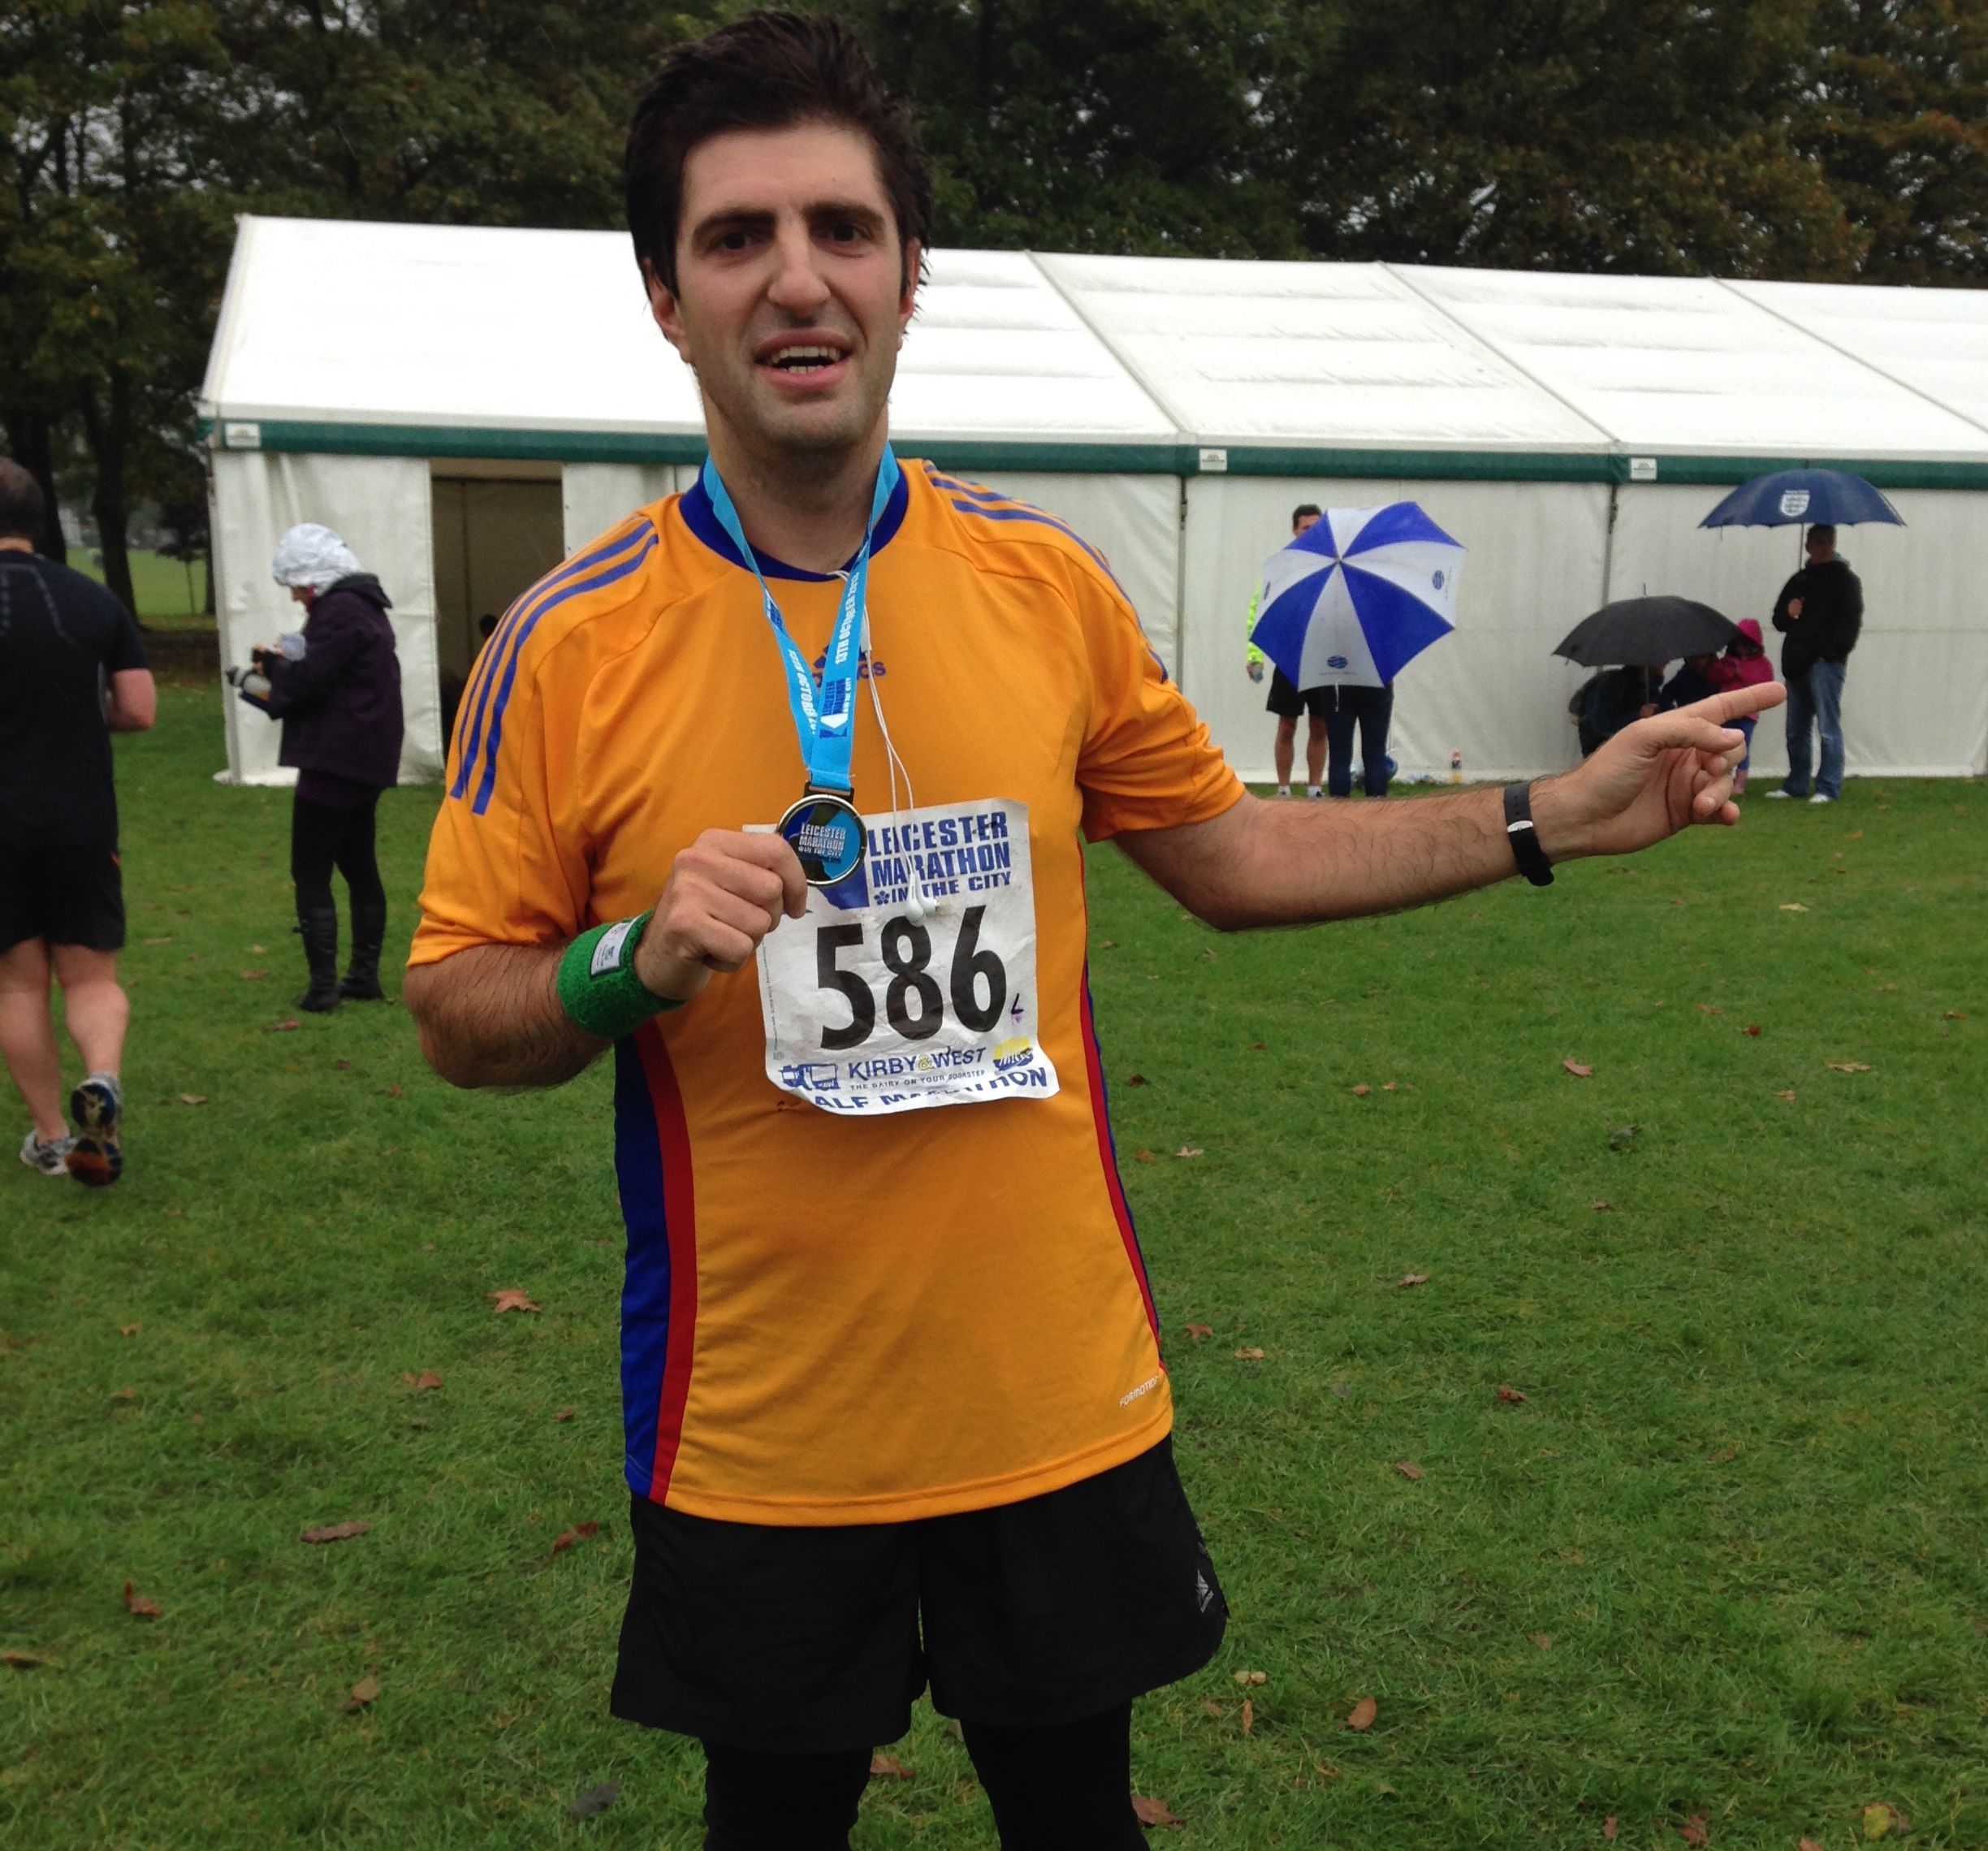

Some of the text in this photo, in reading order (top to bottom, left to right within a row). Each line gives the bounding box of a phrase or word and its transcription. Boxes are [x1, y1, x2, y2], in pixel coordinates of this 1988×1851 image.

[799, 835, 845, 851] MARATHON
[801, 823, 846, 840] LEICESTER
[867, 811, 1009, 857] LEICESTER
[871, 841, 1011, 889] MARATHON
[922, 880, 959, 897] THE
[968, 871, 1011, 892] CITY
[817, 905, 1006, 1050] 586
[872, 1079, 900, 1089] DAIRY
[920, 1075, 945, 1084] YOUR
